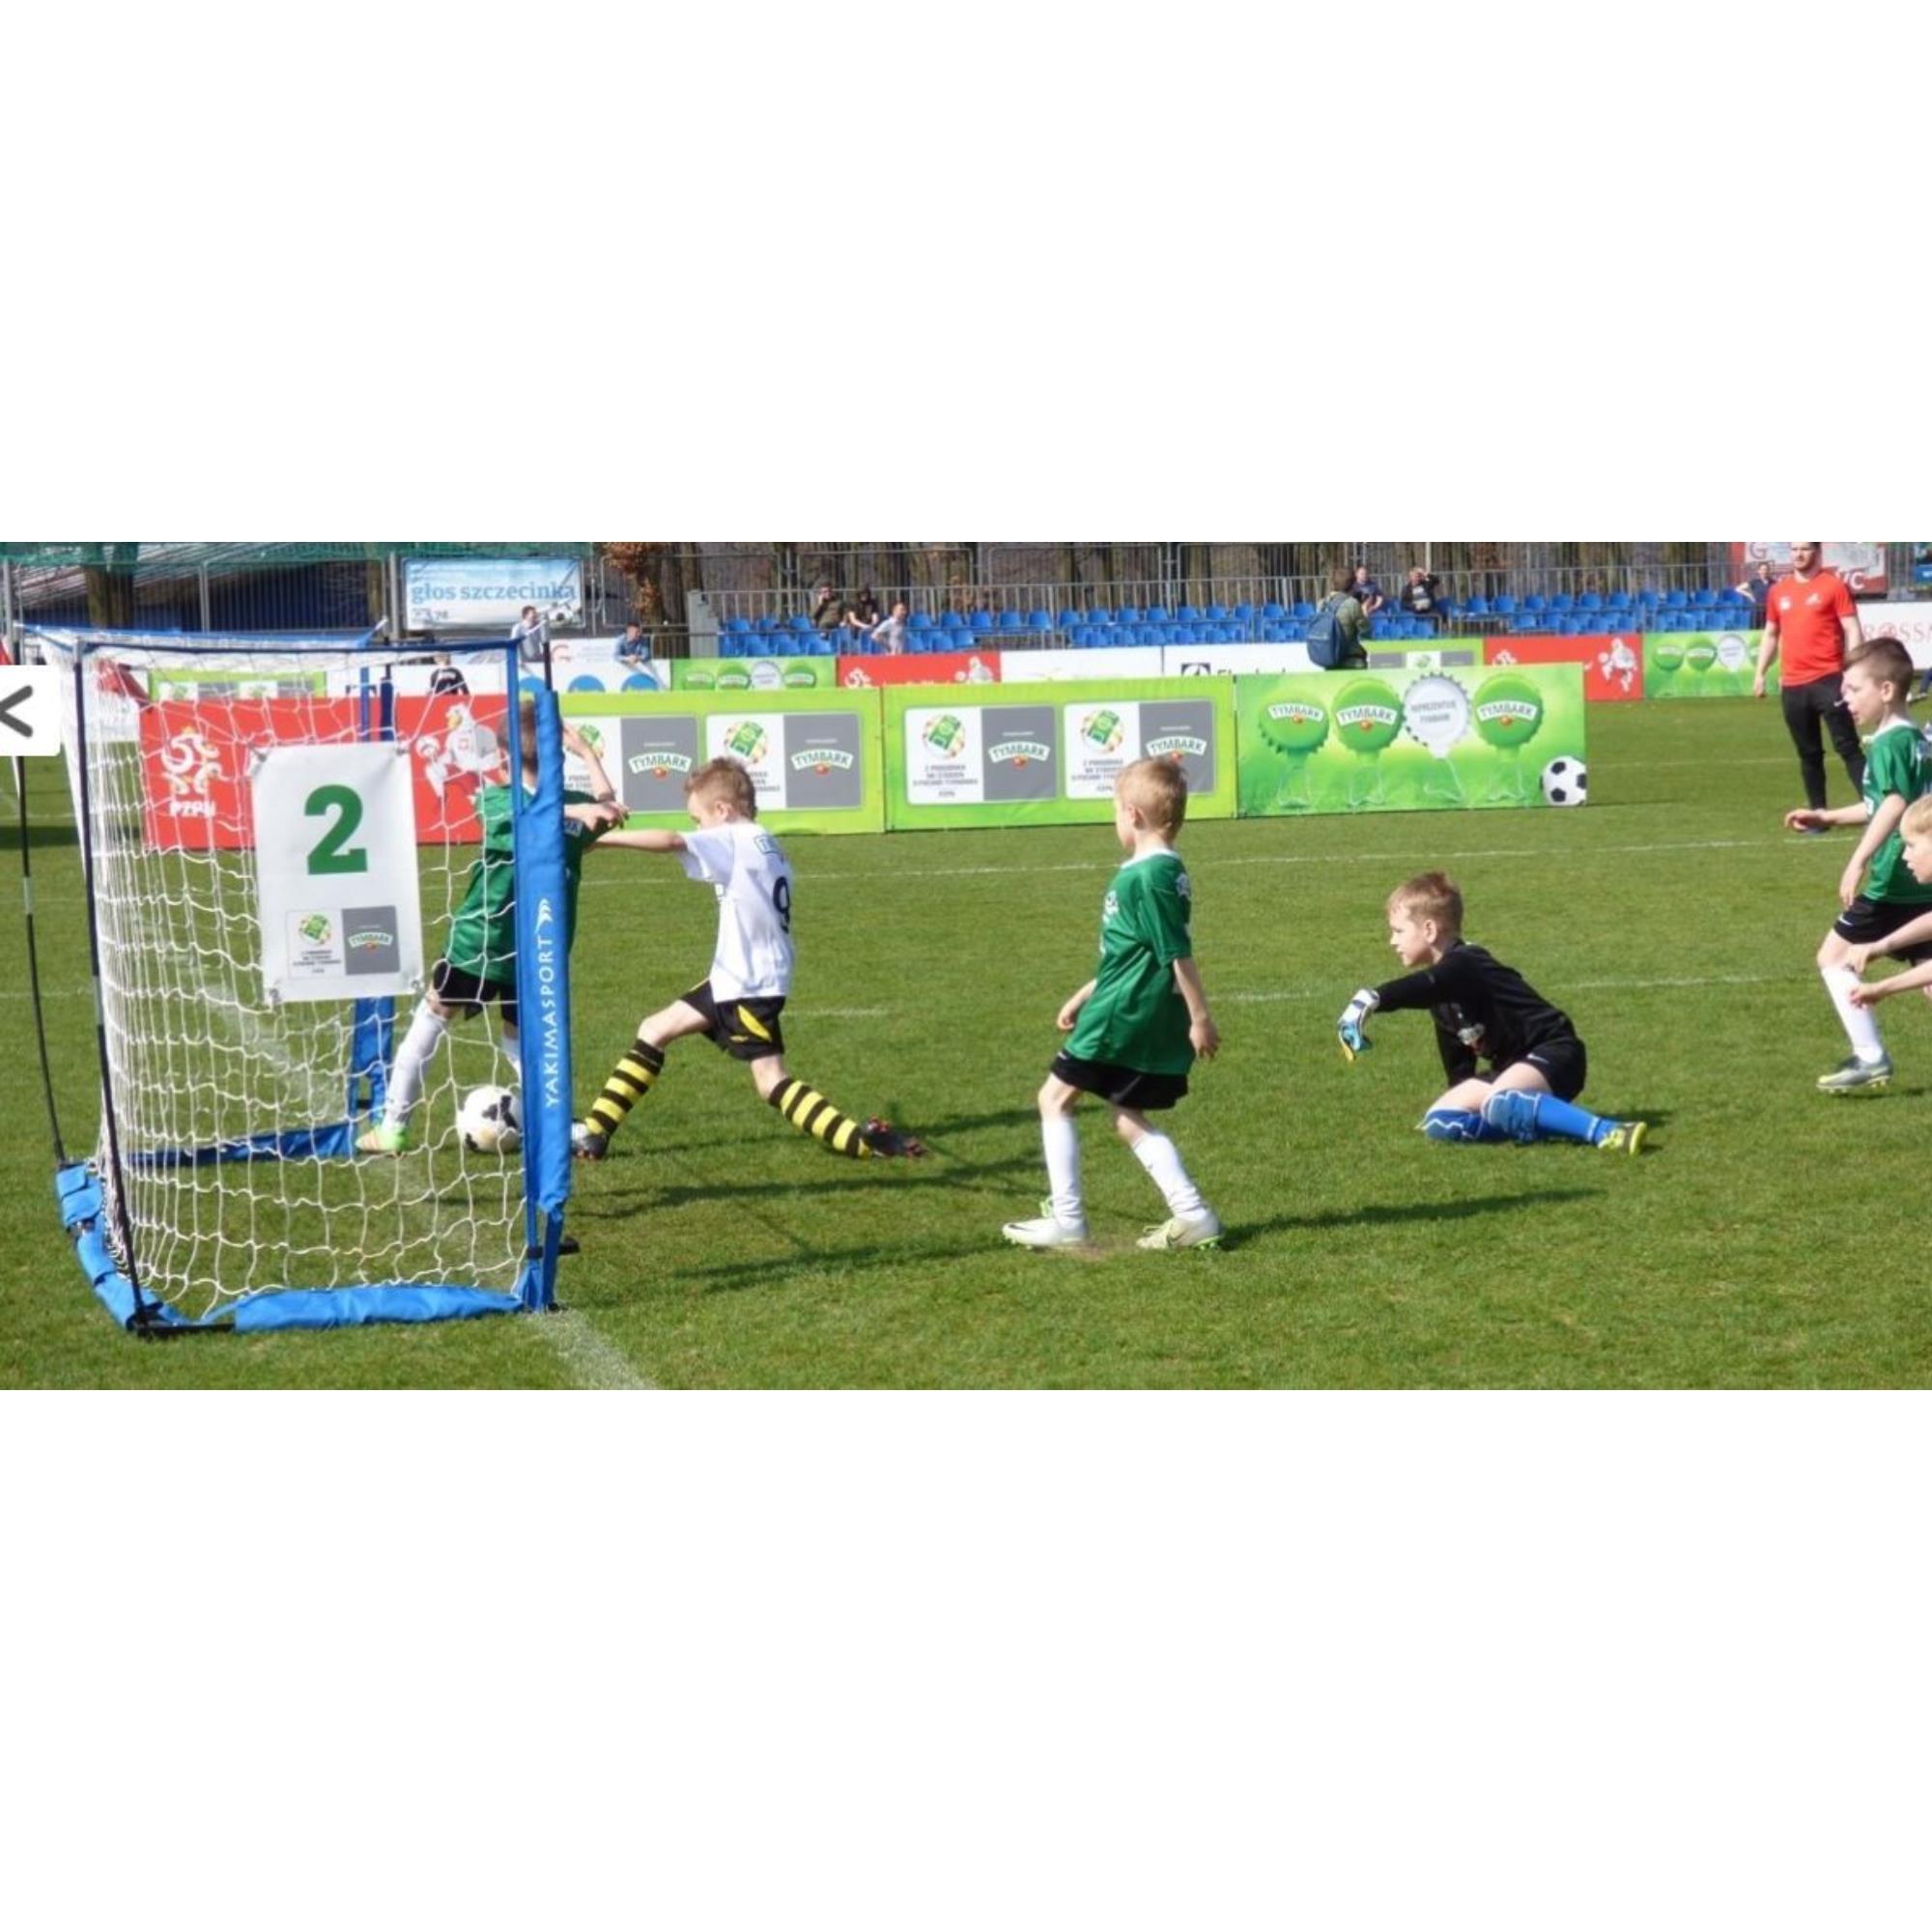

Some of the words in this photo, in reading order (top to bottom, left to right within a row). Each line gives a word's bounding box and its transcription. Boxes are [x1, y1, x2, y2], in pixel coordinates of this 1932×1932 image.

[412, 582, 457, 605] głos
[460, 581, 577, 600] szczecinka
[1863, 621, 1932, 643] ROSS
[1340, 706, 1393, 723] TYMBARK
[1479, 702, 1534, 718] TYMBARK
[992, 743, 1046, 759] TYMBARK
[1150, 737, 1204, 753] TYMBARK
[633, 753, 687, 770] TYMBARK
[794, 750, 849, 766] TYMBARK
[304, 783, 368, 875] 2
[537, 936, 560, 1108] YAKIMASPORT
